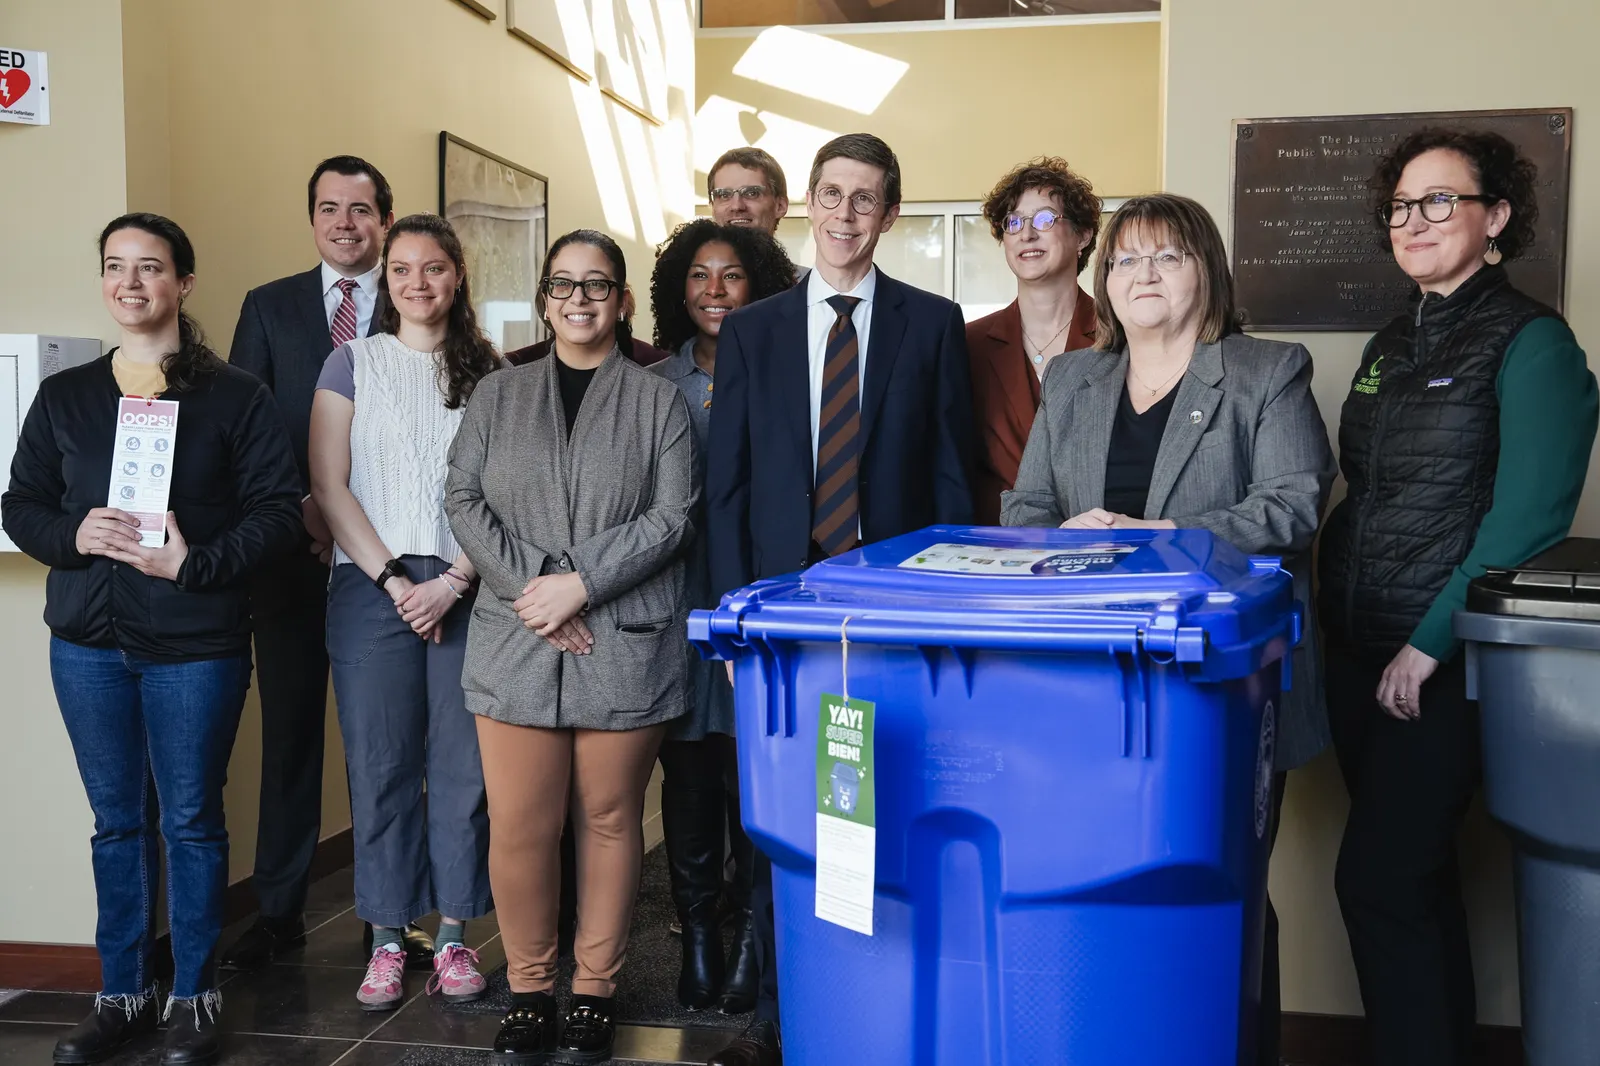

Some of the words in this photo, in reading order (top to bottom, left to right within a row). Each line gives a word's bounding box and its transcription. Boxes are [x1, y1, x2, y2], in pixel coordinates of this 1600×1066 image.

[1319, 135, 1342, 144] The
[1278, 148, 1316, 158] Public
[1323, 147, 1360, 157] Works
[1285, 185, 1294, 193] of
[1298, 184, 1345, 192] Providence
[1294, 219, 1304, 227] 37
[1308, 220, 1331, 228] years
[1289, 228, 1315, 237] James
[1313, 238, 1323, 246] of
[1326, 237, 1340, 245] the
[1278, 247, 1318, 255] exhibited
[1321, 246, 1380, 256] extraordinary
[1240, 257, 1249, 265] in
[1253, 257, 1266, 265] his
[1270, 256, 1303, 266] vigilant
[1306, 256, 1350, 266] protection
[1336, 280, 1374, 290] Vincent
[122, 412, 174, 428] OOPS!
[828, 704, 864, 730] YAY!
[825, 724, 864, 747] SUPER
[827, 741, 861, 762] BIEN!
